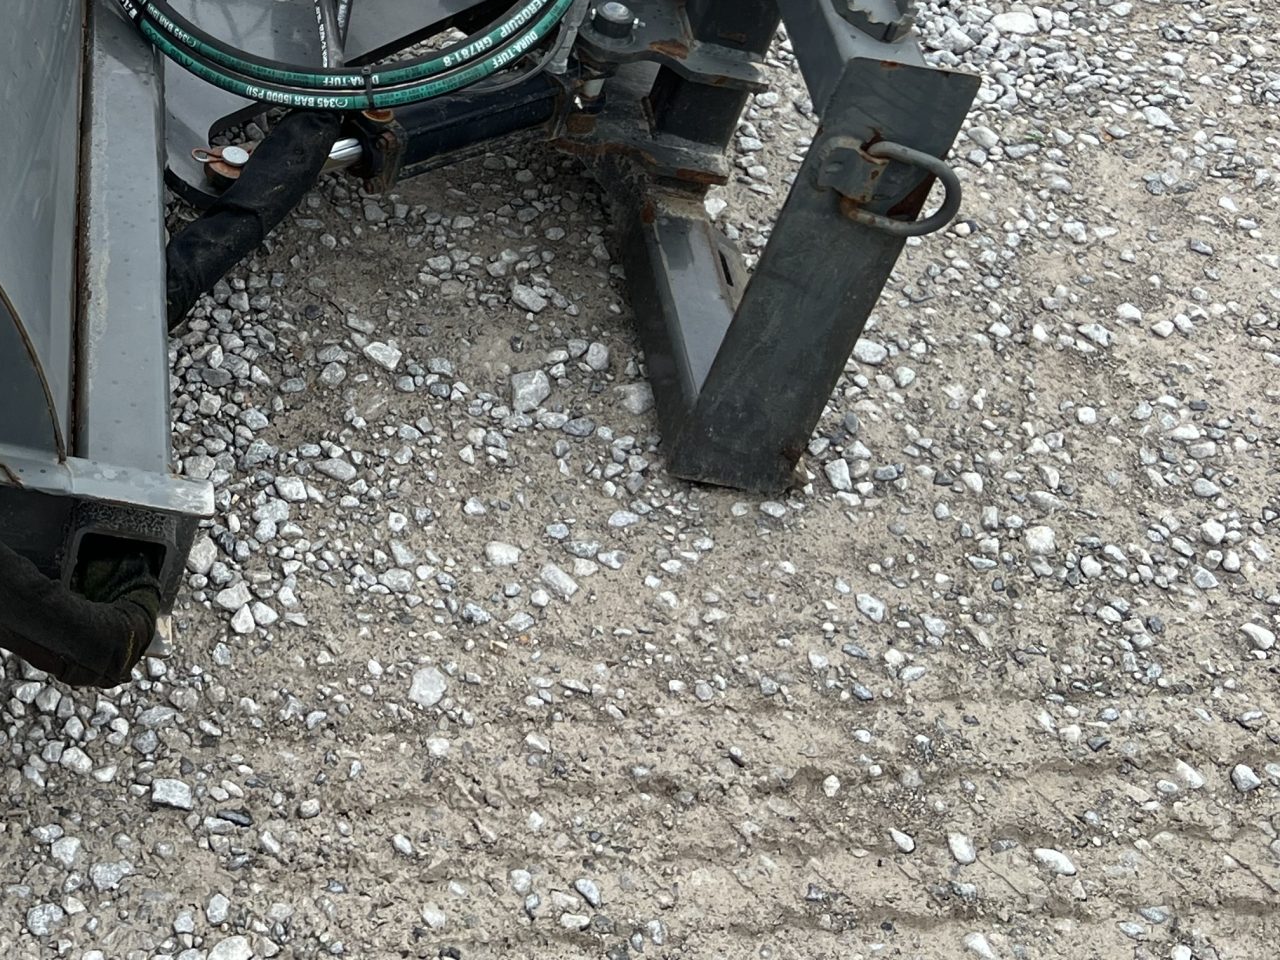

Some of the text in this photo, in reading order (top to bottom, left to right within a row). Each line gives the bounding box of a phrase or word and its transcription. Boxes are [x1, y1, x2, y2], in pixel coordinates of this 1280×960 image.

[442, 35, 494, 68] GH781-8
[322, 74, 380, 87] DRA-TUFF
[294, 95, 317, 107] BAR
[317, 97, 337, 109] 345
